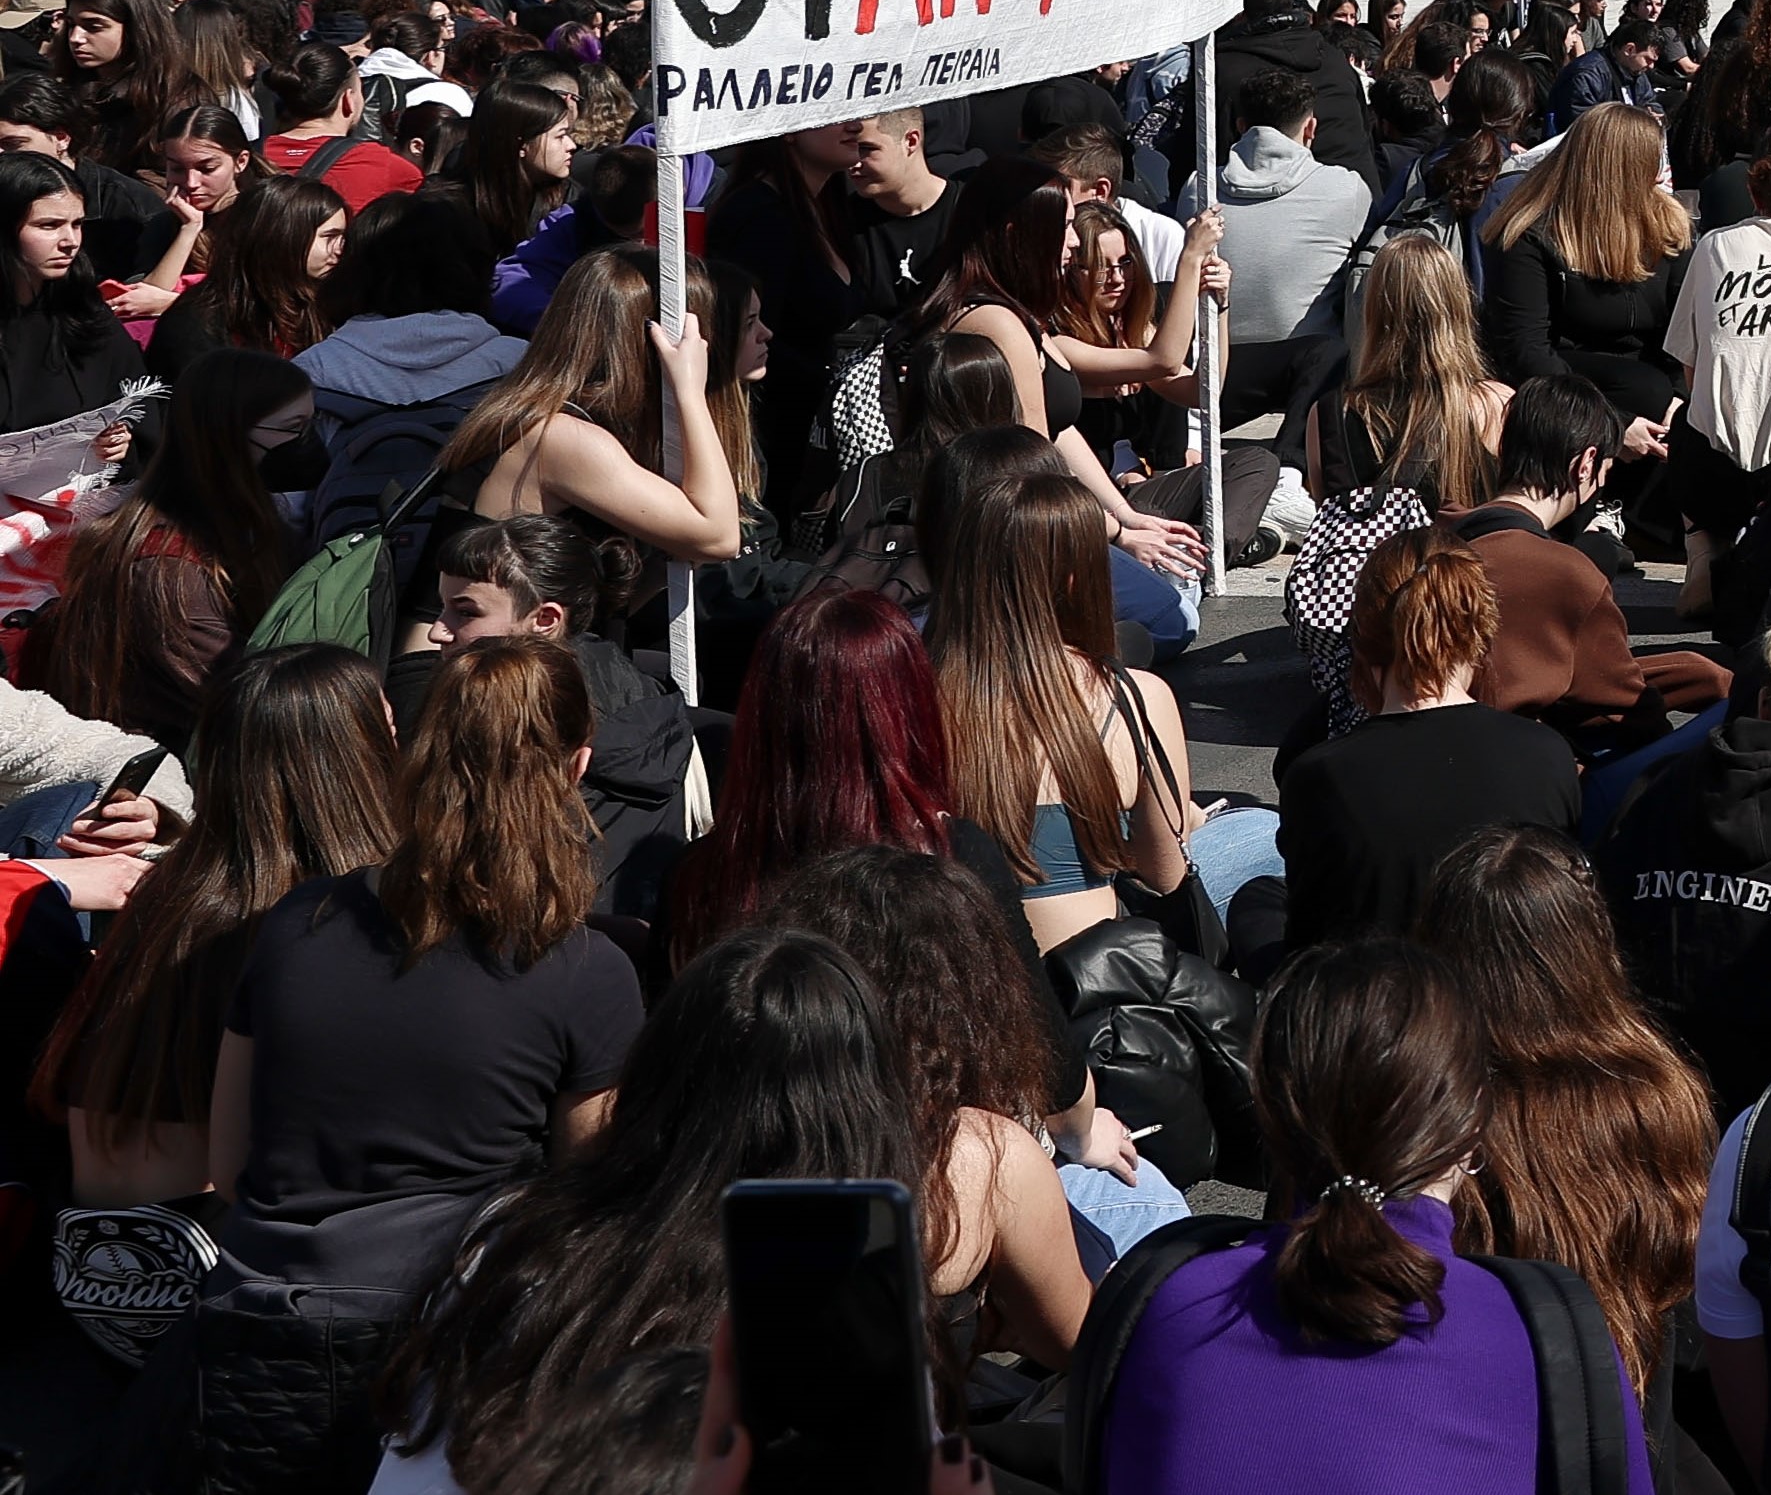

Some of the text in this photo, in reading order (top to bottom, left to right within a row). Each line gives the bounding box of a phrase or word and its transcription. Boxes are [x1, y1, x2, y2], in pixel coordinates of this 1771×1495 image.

[657, 47, 1000, 116] ΡΑΛΛΕΙΟ ΓΕΛ ΠΕΙΡΑΙΑ
[1718, 302, 1744, 327] ET
